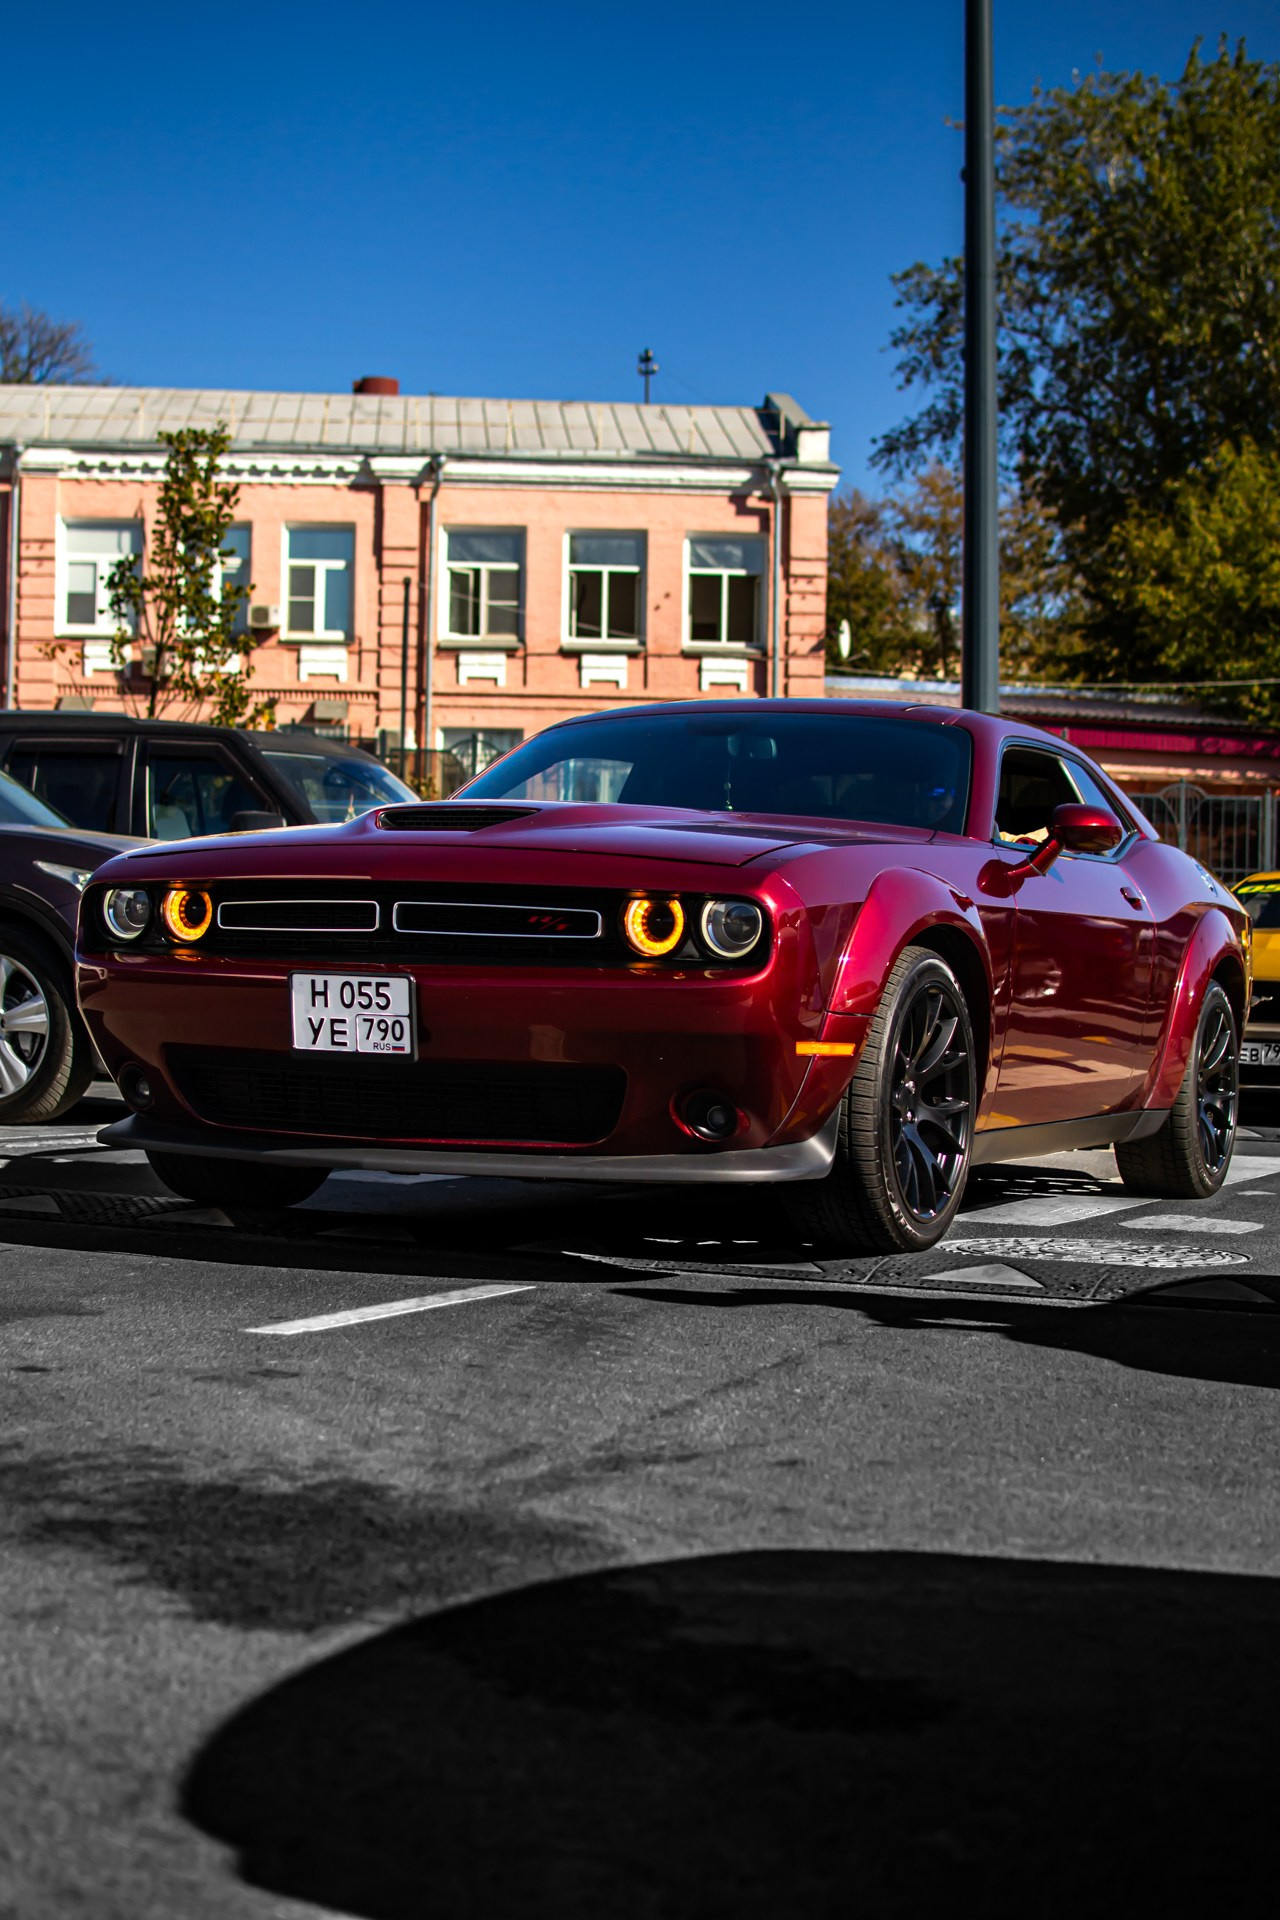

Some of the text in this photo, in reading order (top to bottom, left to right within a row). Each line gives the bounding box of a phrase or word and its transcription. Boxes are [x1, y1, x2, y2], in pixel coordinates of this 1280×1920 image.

[311, 979, 391, 1010] Н 055
[308, 1017, 404, 1047] УЕ 790
[373, 1042, 391, 1051] RUS
